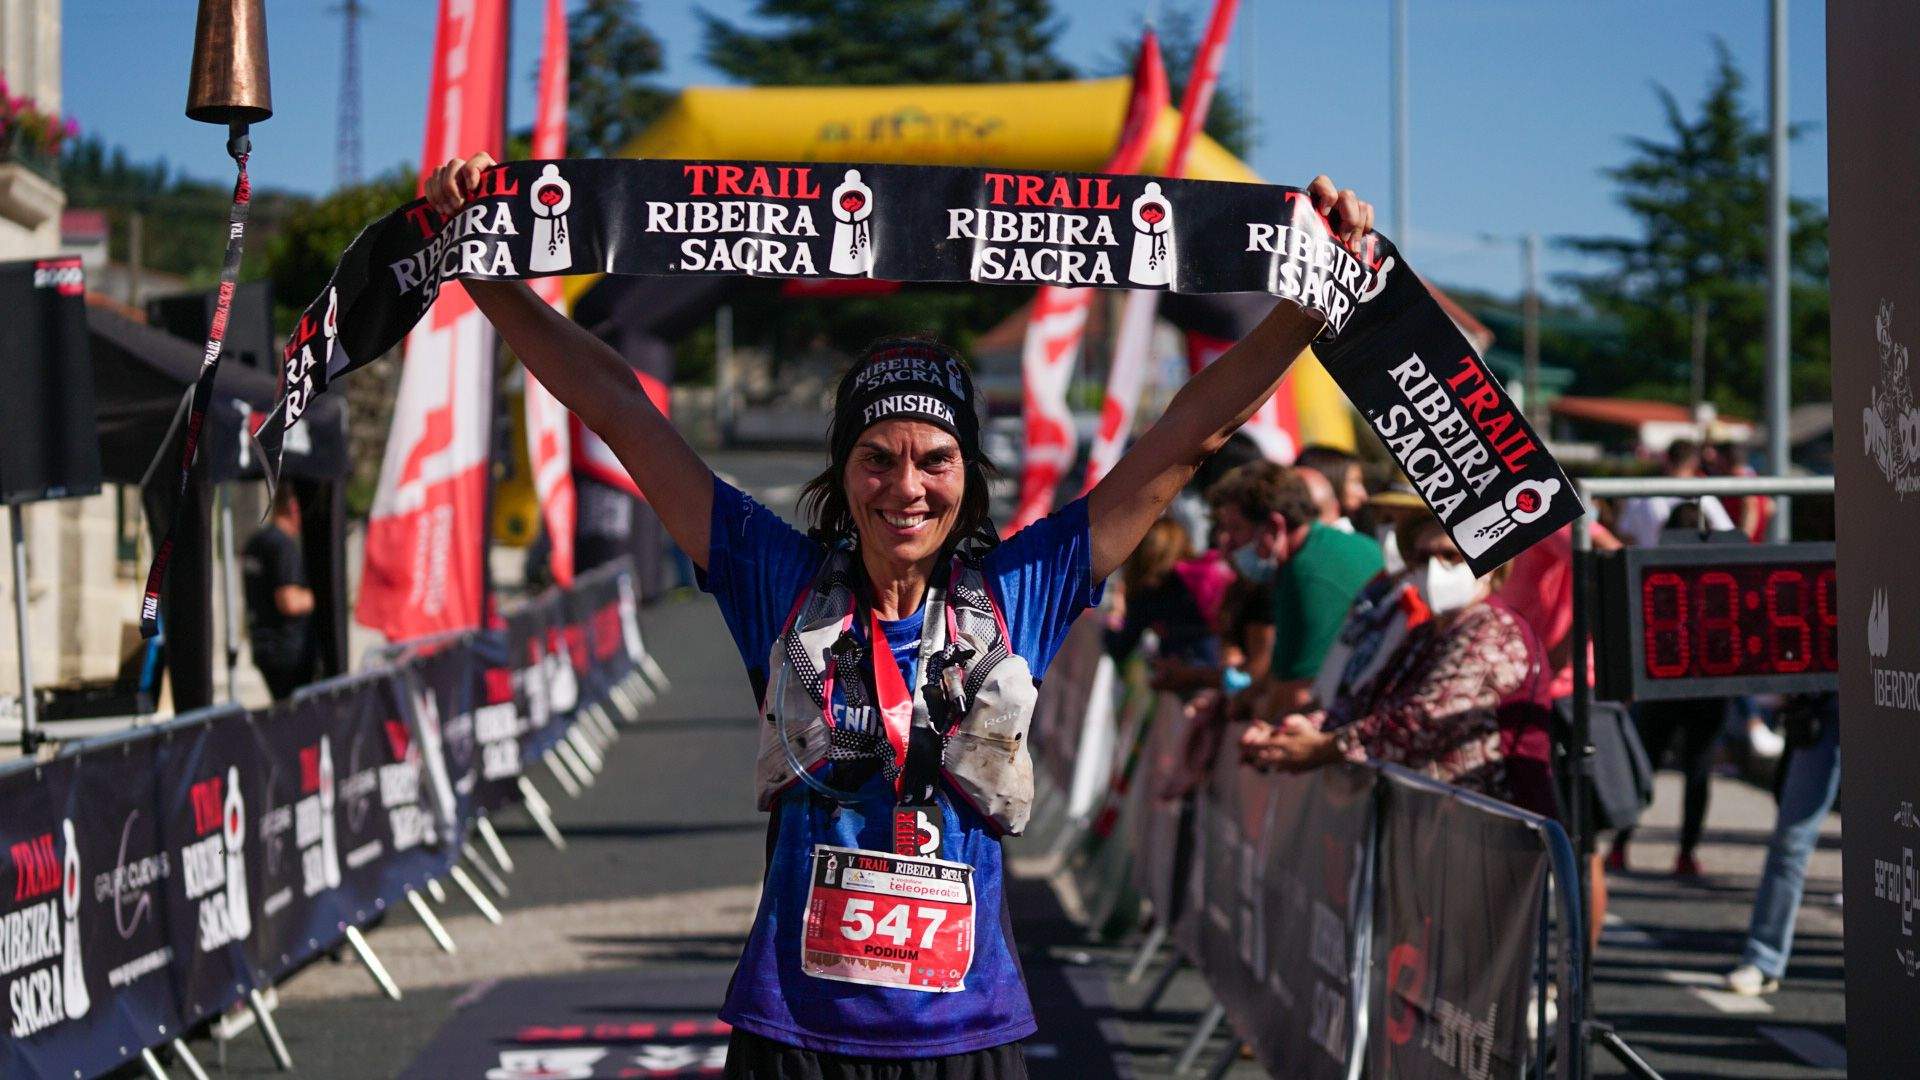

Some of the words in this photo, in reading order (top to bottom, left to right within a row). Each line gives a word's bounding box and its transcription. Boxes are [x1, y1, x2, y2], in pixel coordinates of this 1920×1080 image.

[406, 166, 519, 239] TIL
[684, 165, 821, 199] TRAIL
[984, 172, 1121, 210] TRAIL
[644, 201, 820, 237] RIBEIRA
[946, 208, 1120, 246] RIBEIRA
[389, 202, 520, 296] RIBEIRA
[680, 237, 820, 275] SACRA
[980, 246, 1119, 284] SACRA
[1245, 222, 1374, 301] RIBEIRA
[1279, 261, 1355, 335] SACR
[855, 358, 942, 389] RIBEIRA
[867, 369, 944, 391] SACRA
[1387, 352, 1501, 499] RIBEIRA
[1446, 355, 1539, 475] TRAIL
[1373, 404, 1468, 524] SACRA
[11, 833, 62, 901] TRAIL
[858, 857, 889, 872] TRAIL
[895, 862, 937, 879] RIBEIRA
[840, 898, 947, 949] 547
[864, 944, 919, 960] PODIUM
[10, 964, 64, 1038] SACRA
